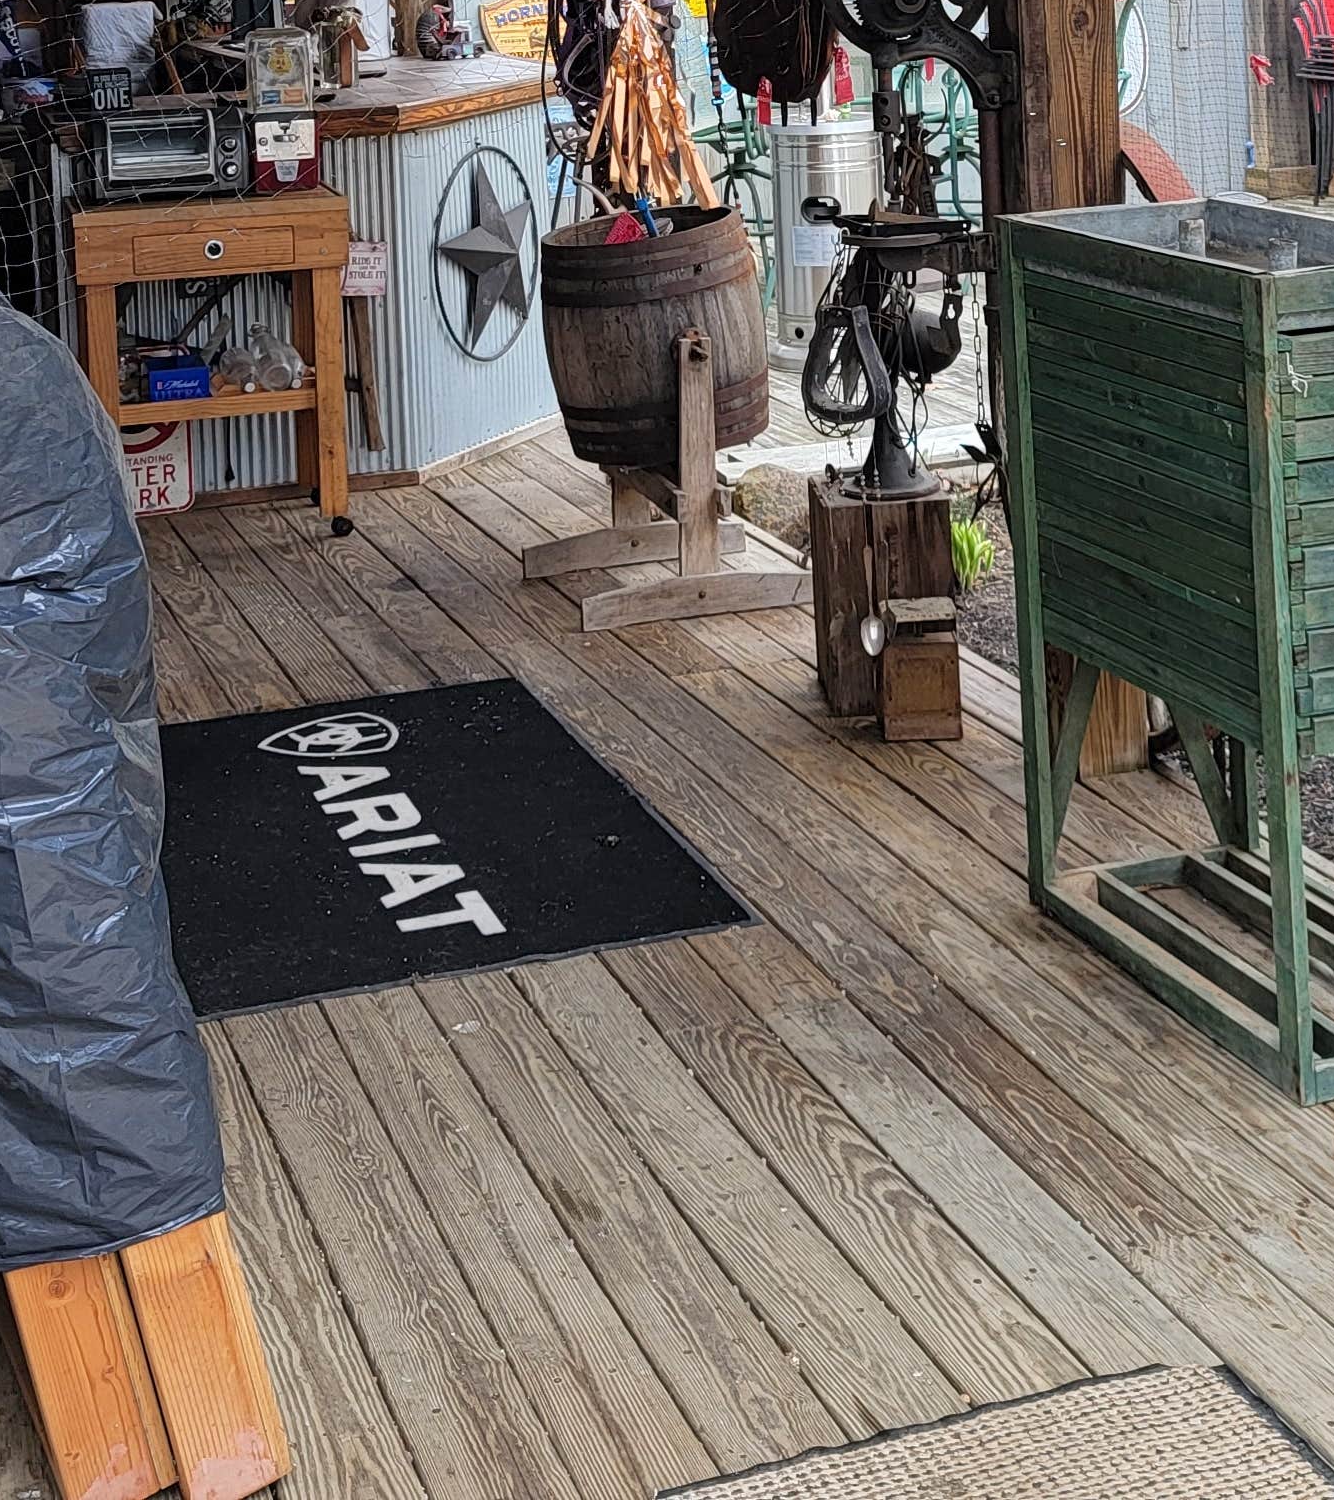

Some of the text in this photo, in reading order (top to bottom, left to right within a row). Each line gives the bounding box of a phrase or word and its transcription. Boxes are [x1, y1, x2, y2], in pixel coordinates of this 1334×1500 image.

[494, 3, 548, 28] HORN
[93, 87, 131, 110] ONE
[126, 452, 174, 467] TANDING
[130, 463, 176, 488] TER
[138, 485, 171, 509] RK
[296, 764, 508, 937] ARIAT
